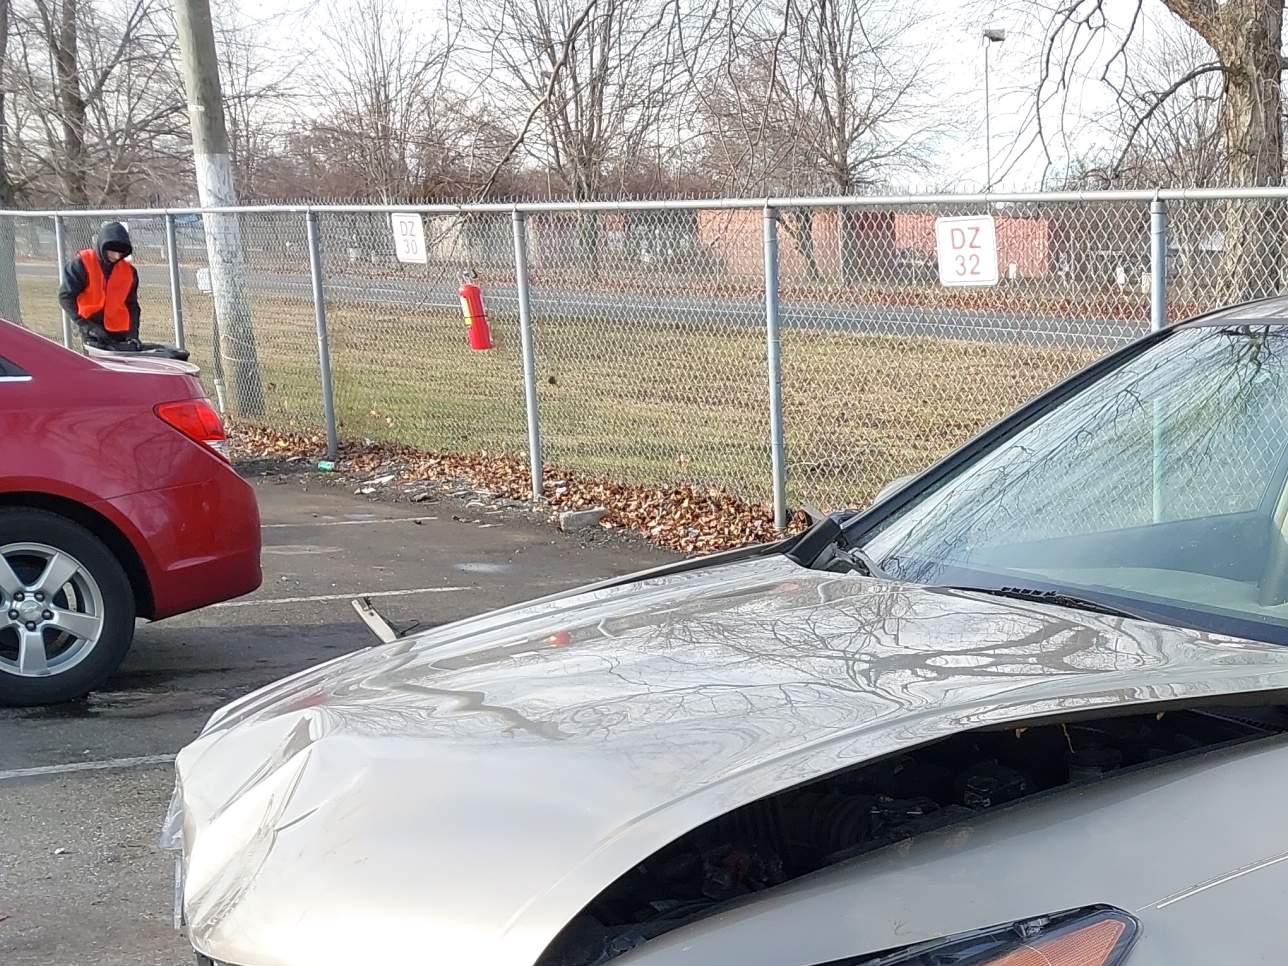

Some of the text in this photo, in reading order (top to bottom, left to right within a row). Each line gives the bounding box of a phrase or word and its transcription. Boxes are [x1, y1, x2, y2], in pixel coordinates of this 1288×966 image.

[400, 220, 416, 236] DZ
[950, 226, 982, 250] DZ
[954, 253, 981, 276] 32
